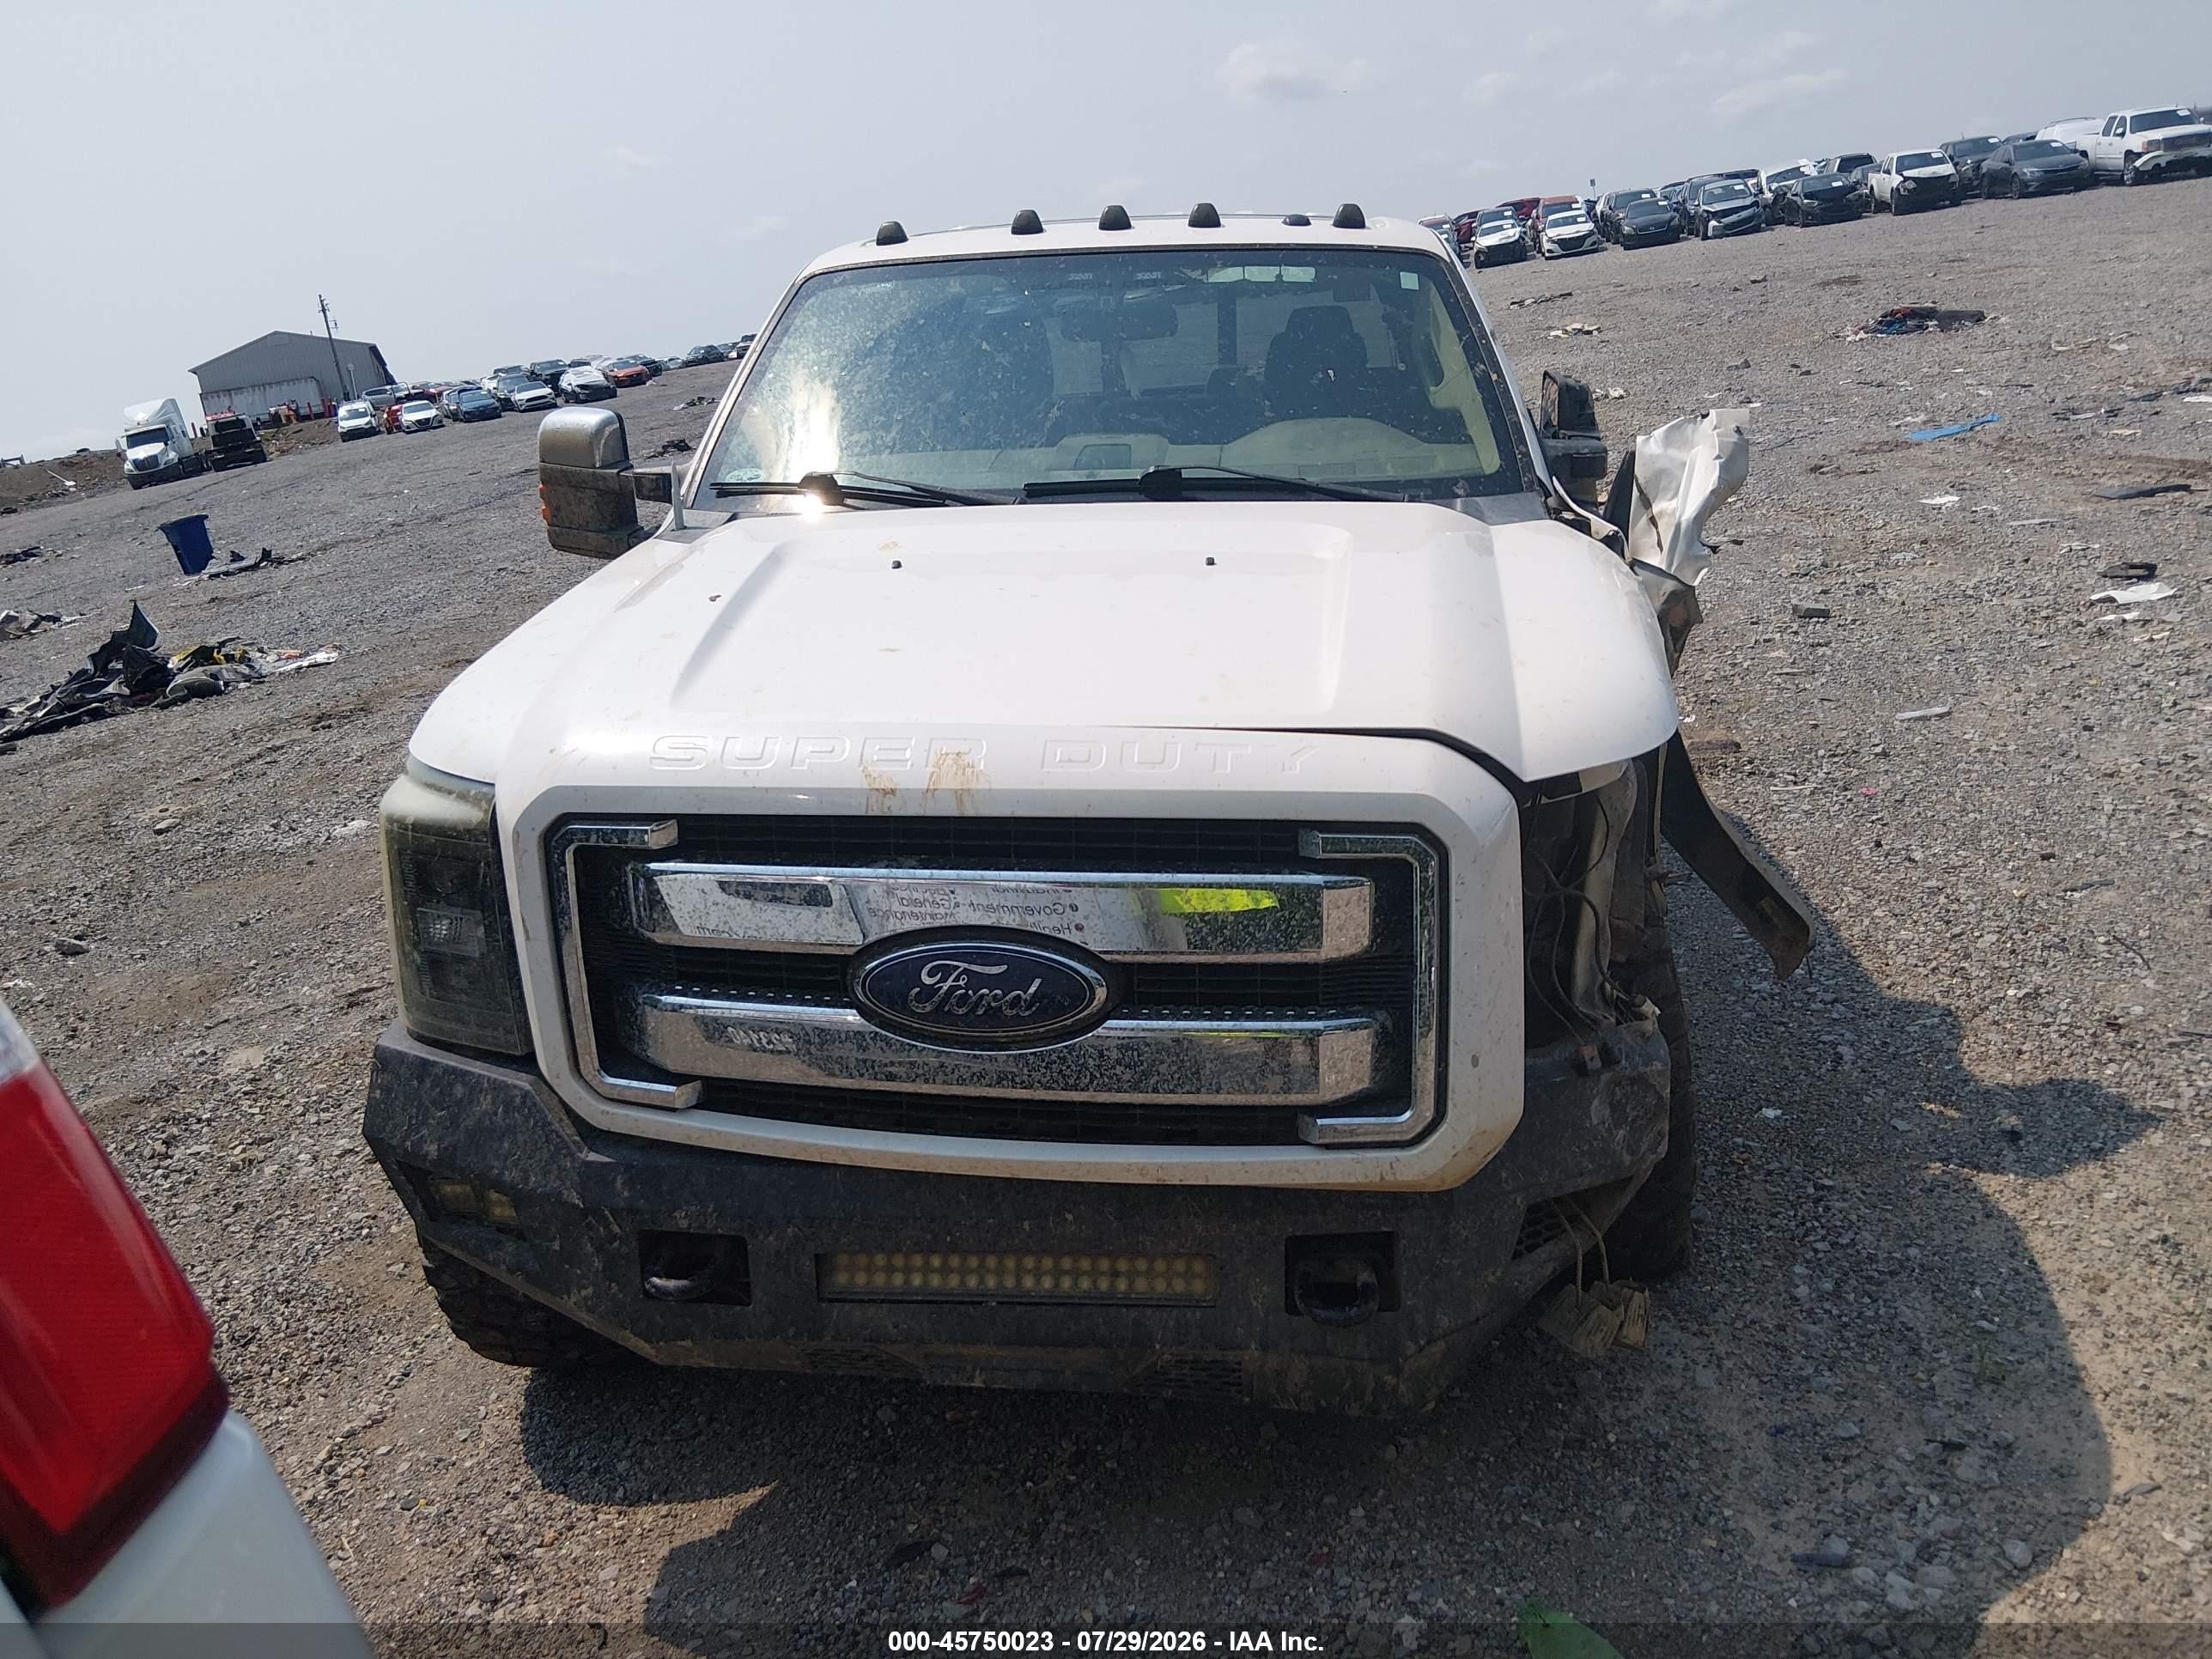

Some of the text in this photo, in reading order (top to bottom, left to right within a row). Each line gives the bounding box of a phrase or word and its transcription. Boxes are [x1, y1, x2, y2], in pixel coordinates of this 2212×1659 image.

[650, 735, 1322, 774] SUPER DUTY
[907, 960, 1042, 1017] Ford
